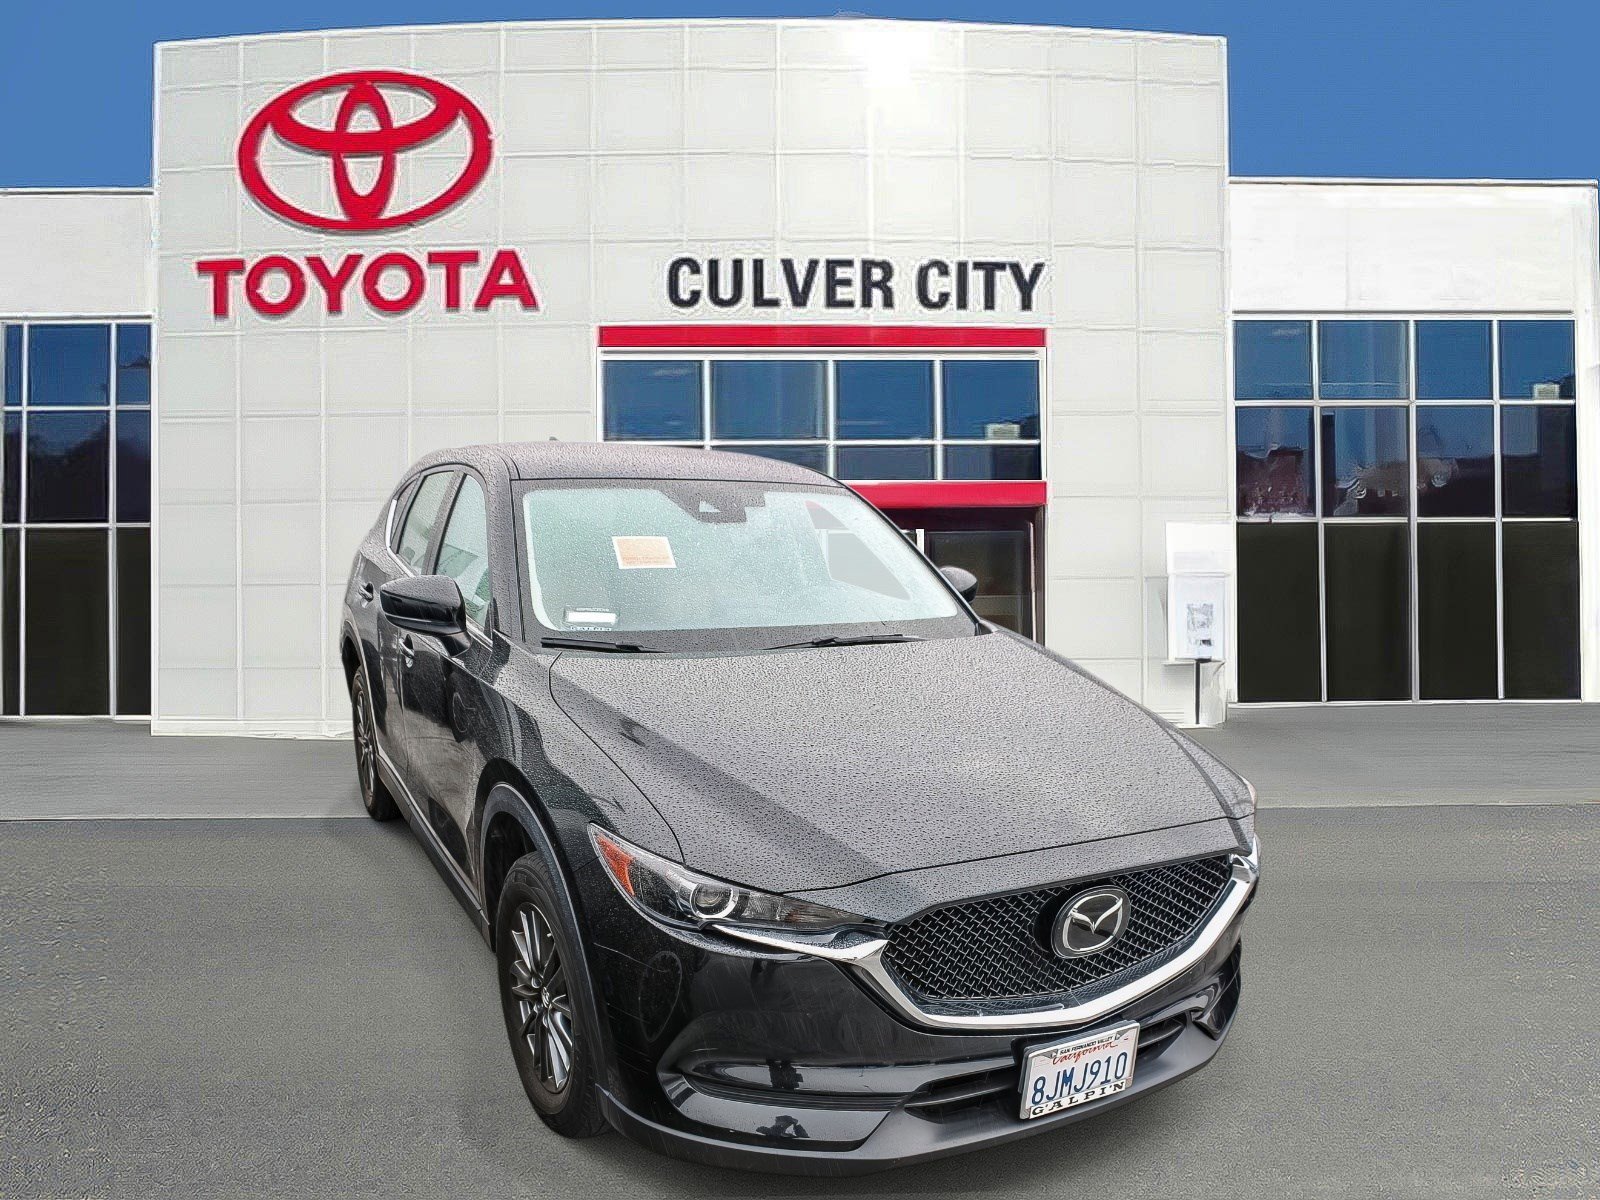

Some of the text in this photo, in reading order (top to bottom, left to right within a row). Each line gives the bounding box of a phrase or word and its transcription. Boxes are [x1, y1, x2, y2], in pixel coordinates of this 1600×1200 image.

[197, 248, 539, 319] TOYOTA
[667, 257, 1046, 311] CULVER CITY
[1071, 1041, 1097, 1052] FERNANDO
[1031, 1052, 1128, 1106] 8JMJ910
